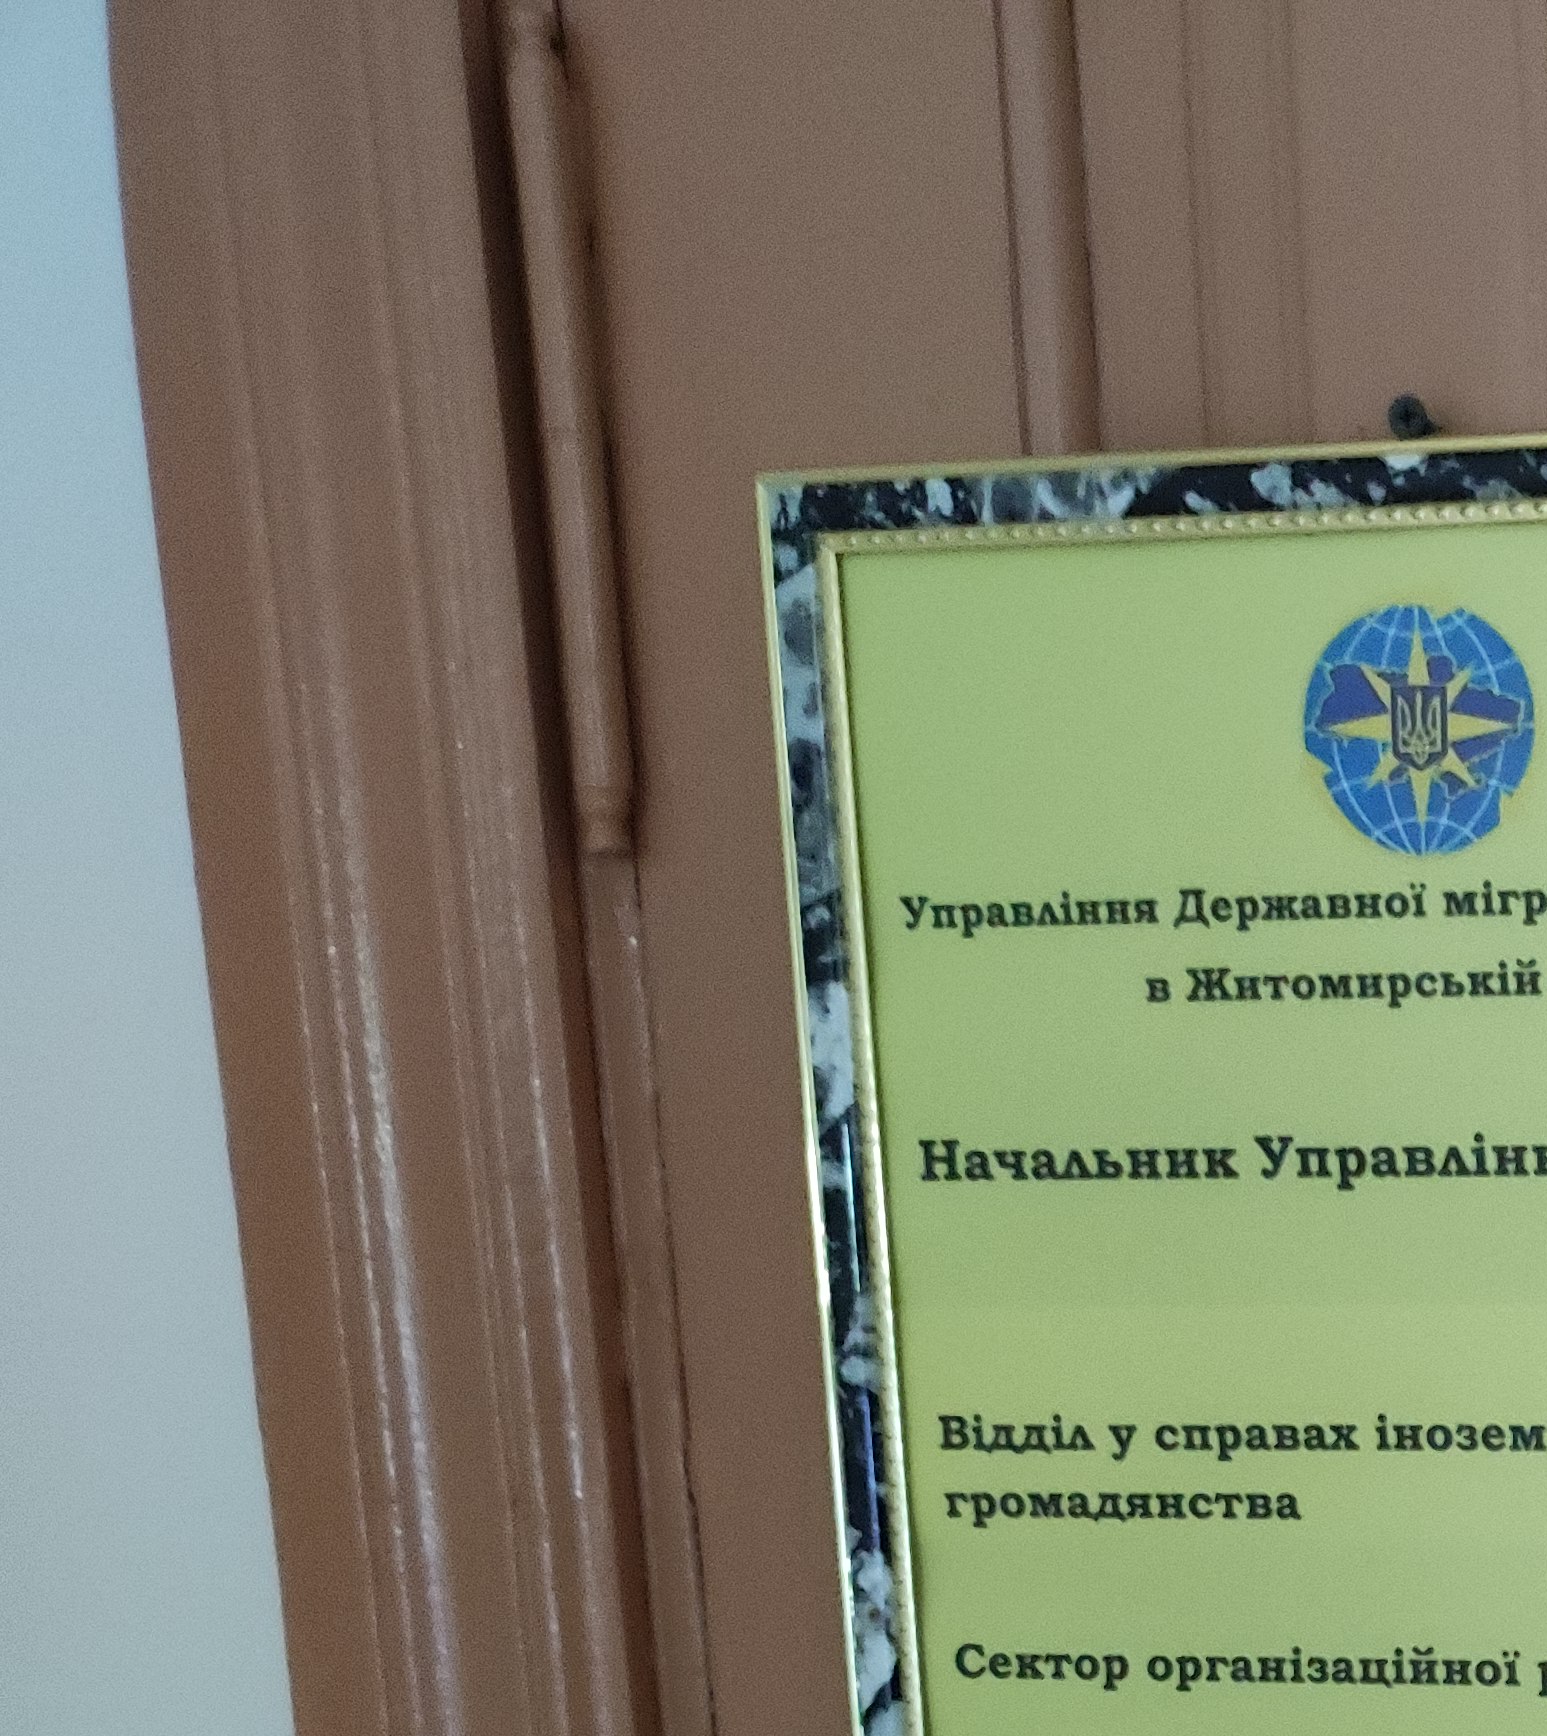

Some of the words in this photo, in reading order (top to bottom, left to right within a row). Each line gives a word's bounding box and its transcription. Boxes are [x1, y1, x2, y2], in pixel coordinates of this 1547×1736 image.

[898, 890, 1160, 939] Управління
[1172, 882, 1427, 933] Державної
[1145, 977, 1172, 1004] в
[1185, 958, 1543, 1010] Житомирській
[917, 1138, 1240, 1182] Начальник
[937, 1413, 1097, 1456] Відділ
[1108, 1423, 1135, 1462] у
[1154, 1423, 1361, 1463] справах
[943, 1491, 1303, 1529] громадянства
[954, 1642, 1130, 1692] Сектор
[1146, 1645, 1521, 1693] організаційної
